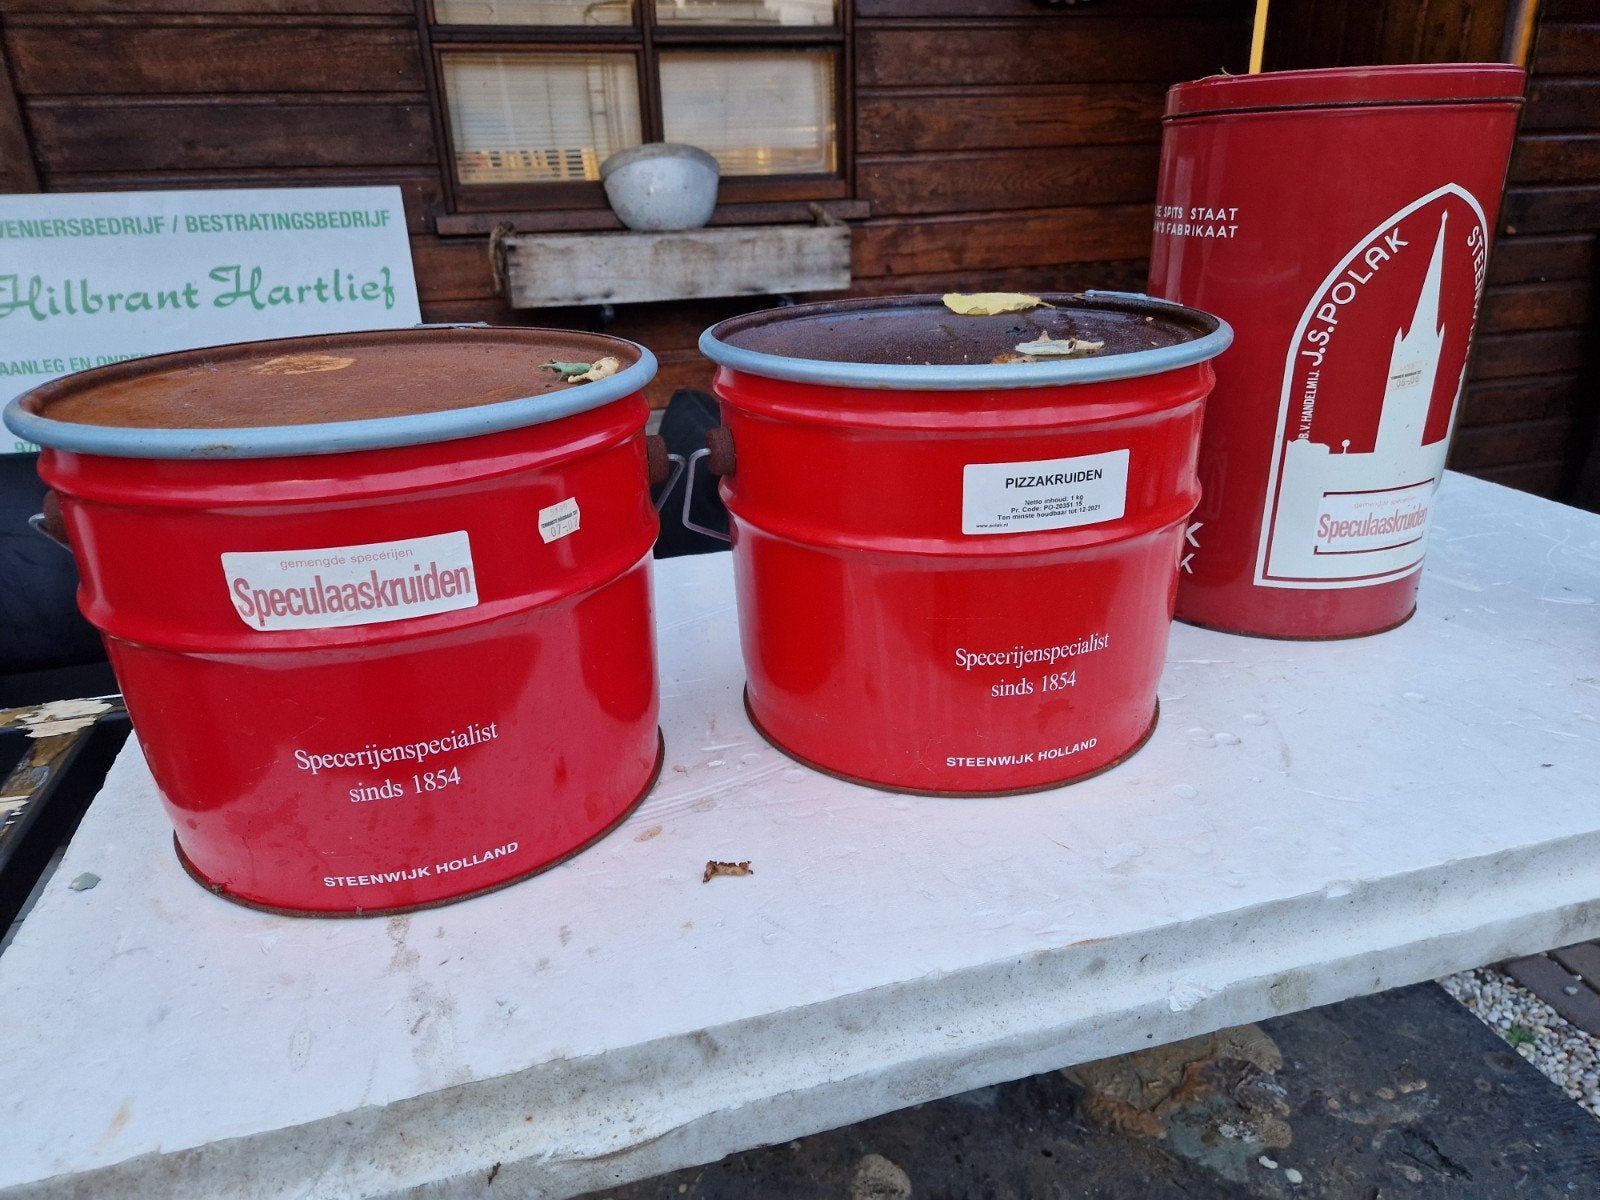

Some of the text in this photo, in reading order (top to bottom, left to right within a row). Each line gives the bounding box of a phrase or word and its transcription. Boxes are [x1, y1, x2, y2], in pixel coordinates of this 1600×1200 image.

[185, 210, 390, 233] BESTRATINGSBEDRIJF
[1163, 205, 1184, 220] SPITS
[1190, 207, 1239, 221] STAAT
[1166, 222, 1239, 238] FABRIKAAT
[0, 264, 395, 321] Hilbrant Hartlief
[0, 357, 65, 376] AANLEG
[70, 356, 91, 371] EN
[1005, 468, 1103, 489] PIZZAKRUIDEN
[1317, 503, 1428, 543] Speculaaskruiden
[280, 548, 413, 571] gemengde specerijen
[233, 561, 471, 627] Speculaaskruiden
[955, 632, 1109, 671] Specerijenspecialist
[991, 670, 1077, 697] sinds 1854
[294, 721, 498, 775] Specerijenspecialist
[946, 737, 1098, 767] STEENWIJK HOLLAND
[349, 766, 461, 803] sinds 1854
[324, 841, 519, 888] STEENWIJK HOLLAND
